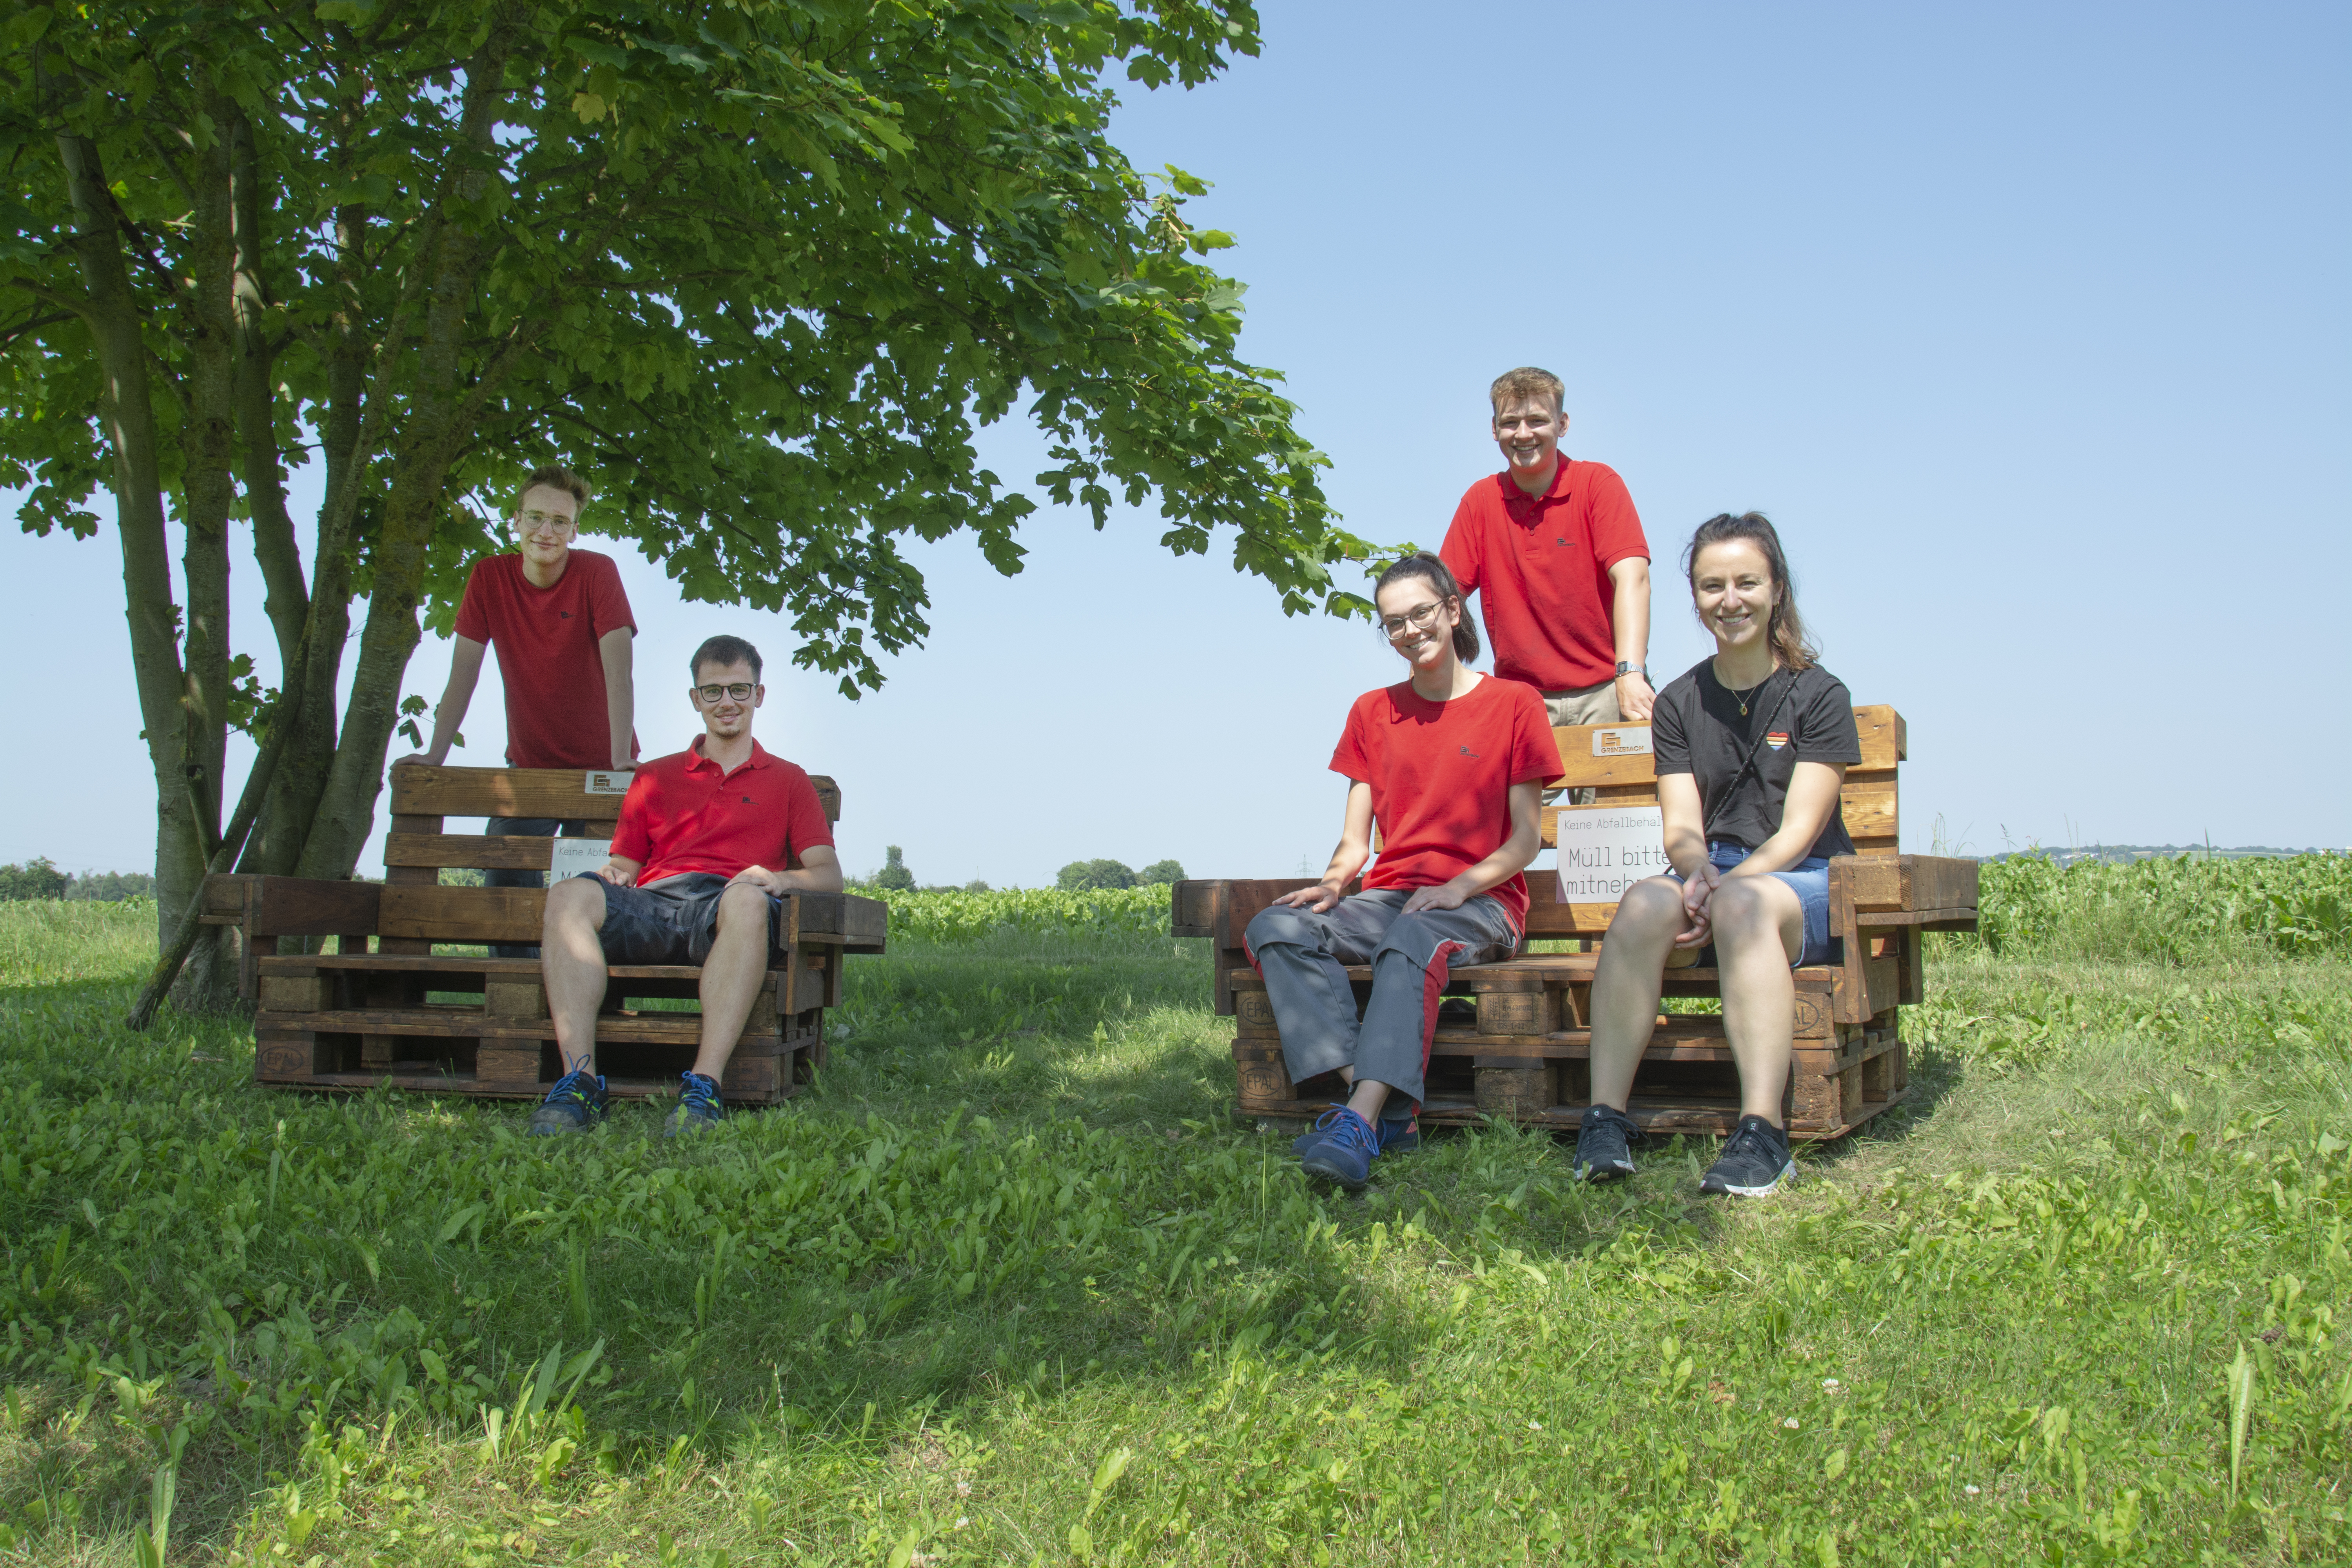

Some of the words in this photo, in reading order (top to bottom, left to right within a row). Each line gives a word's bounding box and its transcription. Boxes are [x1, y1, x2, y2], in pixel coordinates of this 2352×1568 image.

[1564, 819, 1592, 830] Keine
[1597, 816, 1663, 828] Abfallbehäl
[559, 847, 583, 856] Keine
[587, 848, 609, 857] Abfa
[1569, 847, 1612, 867] Müll
[1623, 845, 1671, 866] bitte
[1567, 873, 1641, 895] mitneh
[267, 1053, 297, 1065] EPAL
[1247, 1074, 1276, 1090] EPAL
